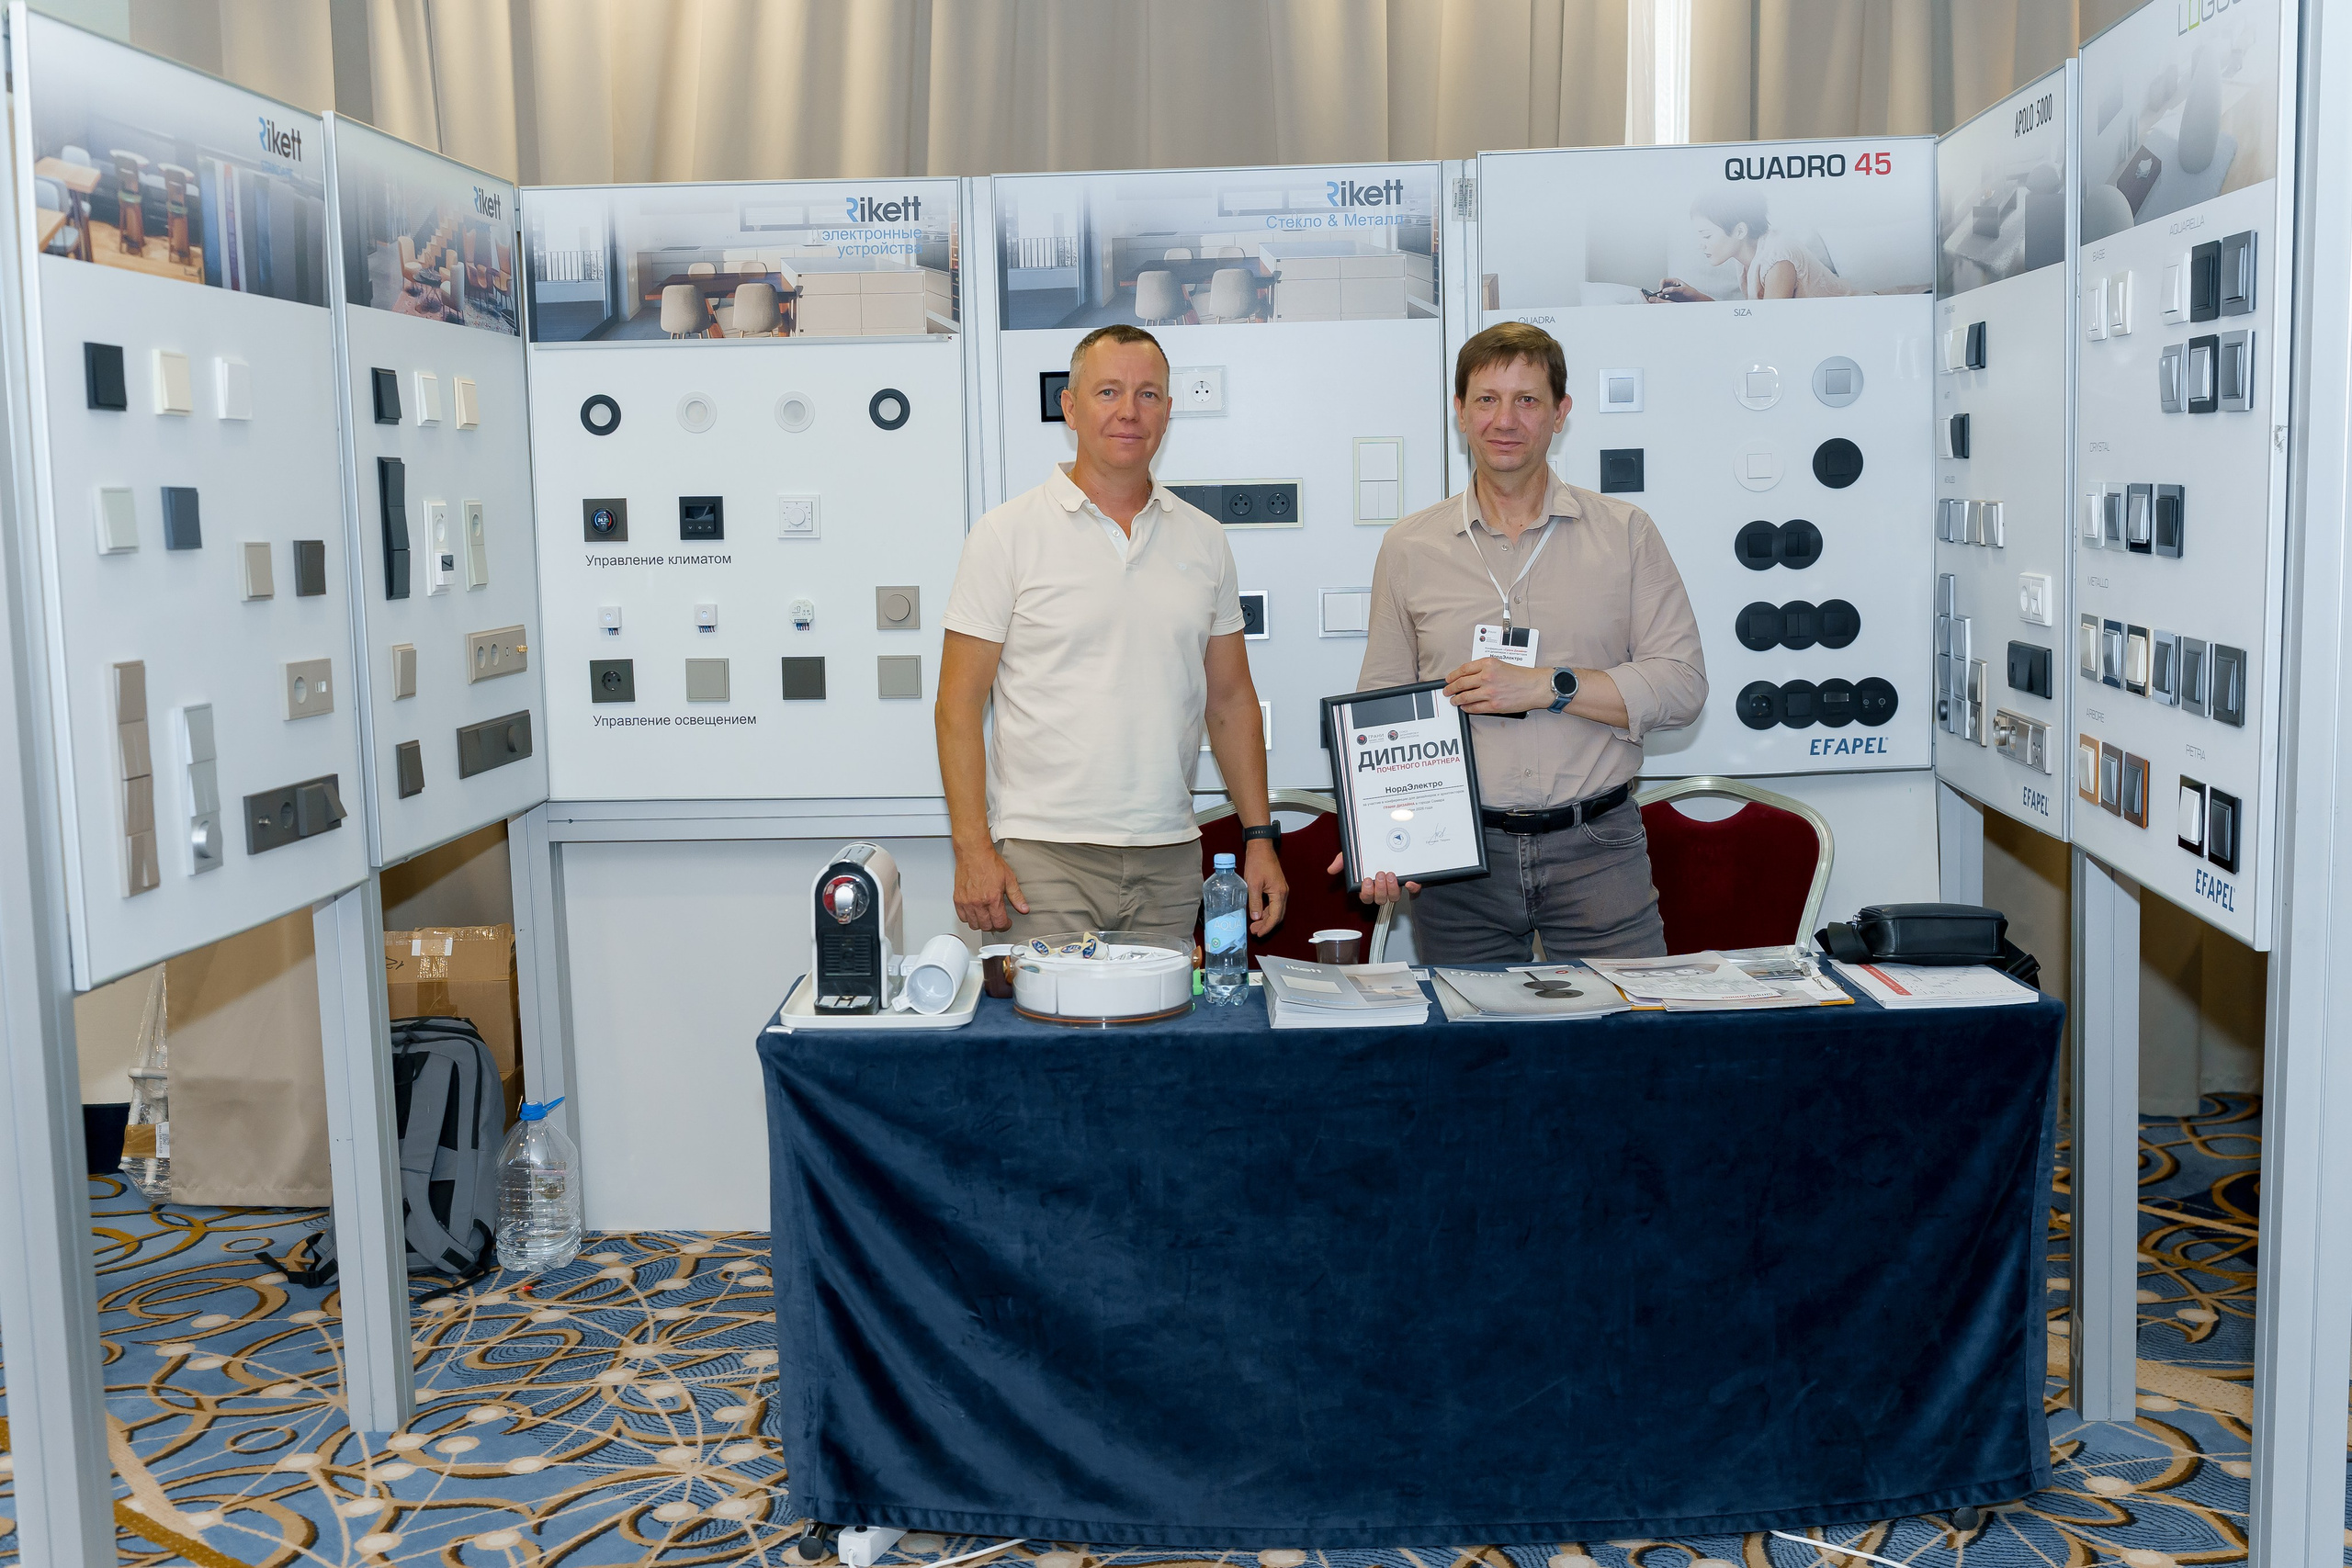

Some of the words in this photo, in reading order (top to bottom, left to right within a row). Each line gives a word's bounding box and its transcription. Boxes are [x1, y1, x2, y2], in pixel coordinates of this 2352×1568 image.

[2178, 0, 2242, 37] LOG
[2015, 103, 2033, 139] APOLO
[2036, 93, 2052, 128] 5000
[258, 116, 301, 162] Rikett
[1725, 153, 1846, 181] QUADRO
[1854, 152, 1892, 175] 45
[1326, 179, 1403, 207] Rikett
[473, 186, 502, 220] Rikett
[845, 196, 922, 222] Rikett
[1266, 215, 1322, 229] Стекло
[1328, 213, 1338, 227] &
[1344, 213, 1404, 227] Металл
[822, 228, 922, 243] электронные
[837, 242, 923, 259] устройства
[1518, 315, 1556, 324] QUADRA
[1734, 308, 1753, 317] SIZA
[585, 555, 664, 569] Управление
[668, 554, 731, 566] климатом
[593, 715, 671, 728] Управление
[674, 716, 757, 727] освещением
[1810, 737, 1887, 755] EFAPEL
[1358, 739, 1460, 773] ДИПЛОМ
[1376, 762, 1420, 773] ПОЧЕТНОГО
[1421, 756, 1461, 767] ПАРТНЕРА
[1385, 780, 1443, 794] НордЭлектро
[2022, 785, 2049, 817] EFAPEL
[2196, 868, 2234, 912] EFAPEL
[1214, 919, 1242, 931] AQUA
[1450, 970, 1508, 978] EFAPEL
